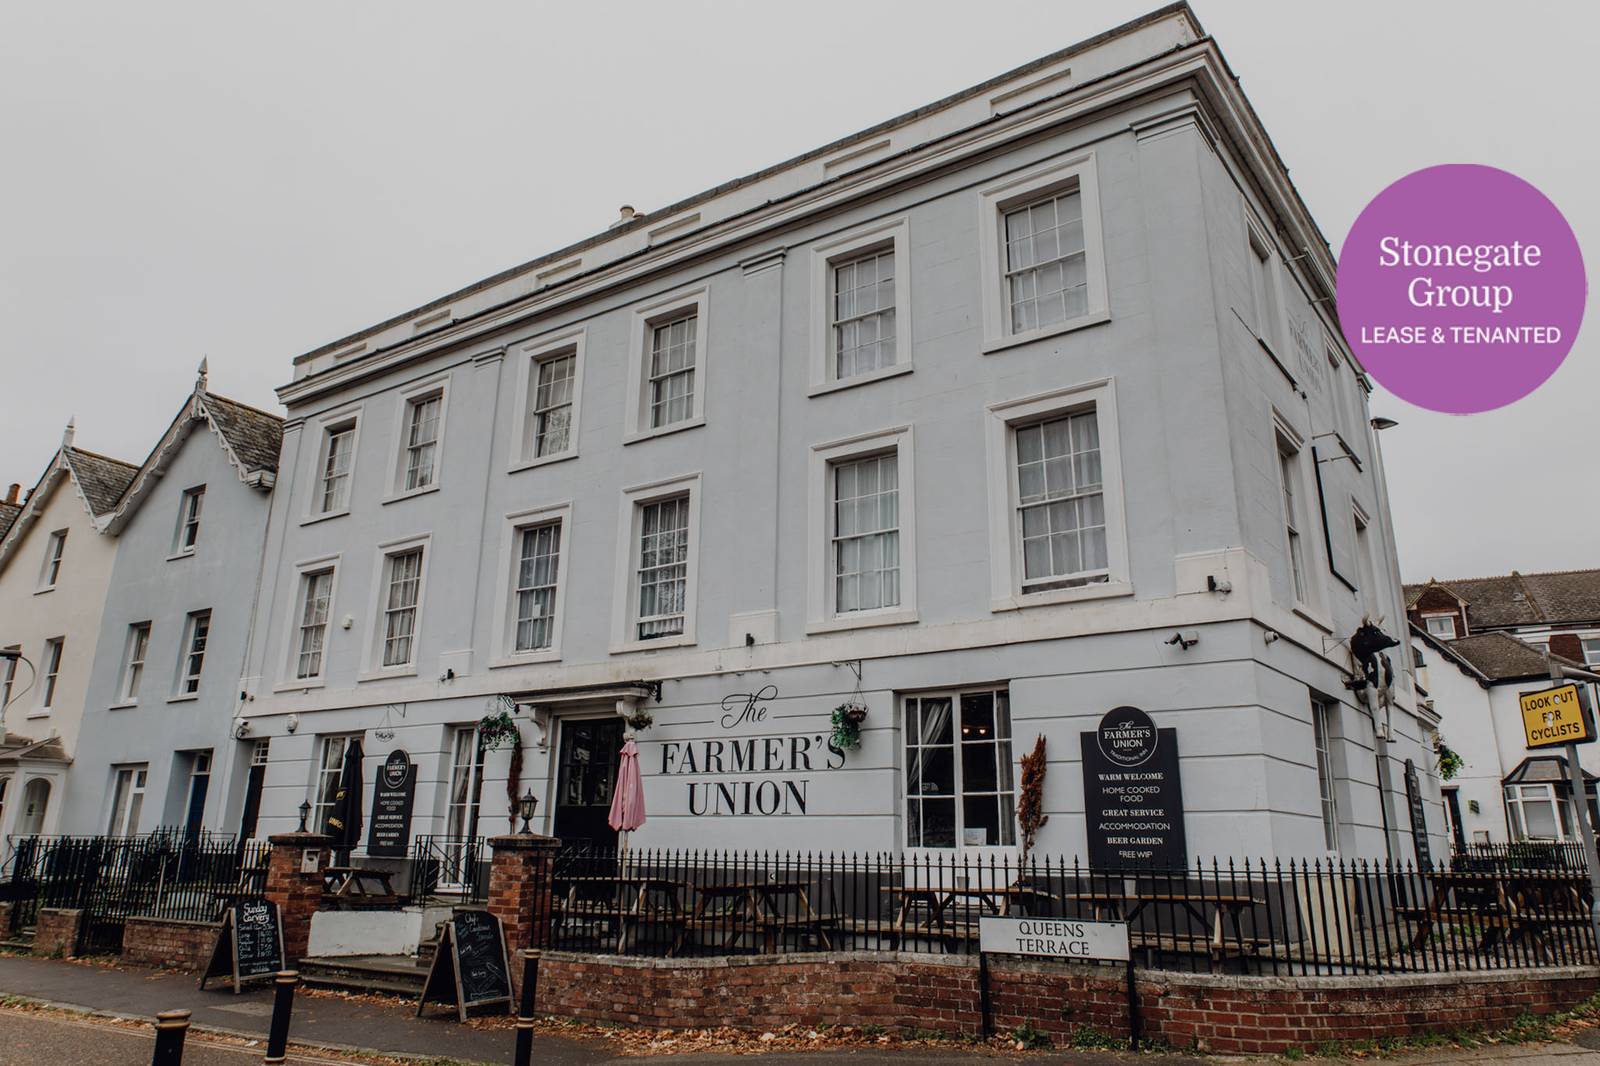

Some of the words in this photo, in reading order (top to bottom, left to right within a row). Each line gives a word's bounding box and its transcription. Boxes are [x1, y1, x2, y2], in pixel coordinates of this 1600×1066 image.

[721, 685, 778, 729] The
[1525, 697, 1551, 711] LOOK
[1553, 691, 1573, 705] OUT
[1542, 710, 1562, 723] FOR
[1104, 729, 1151, 739] FARMER'S
[1531, 722, 1580, 740] CYCLISTS
[1113, 739, 1143, 748] UNION
[659, 734, 847, 775] FARMER'S
[1123, 772, 1164, 780] WELCOME
[1126, 786, 1160, 794] COOKED
[686, 779, 810, 816] UNION
[1129, 809, 1165, 817] SERVICE
[1099, 823, 1171, 831] ACCOMMODATION
[1107, 837, 1129, 845] BEER
[1129, 837, 1163, 845] GARDEN
[243, 900, 268, 915] Sunday
[242, 913, 270, 925] Carvery
[1019, 921, 1085, 938] QUEENS
[1016, 938, 1090, 956] TERRACE
